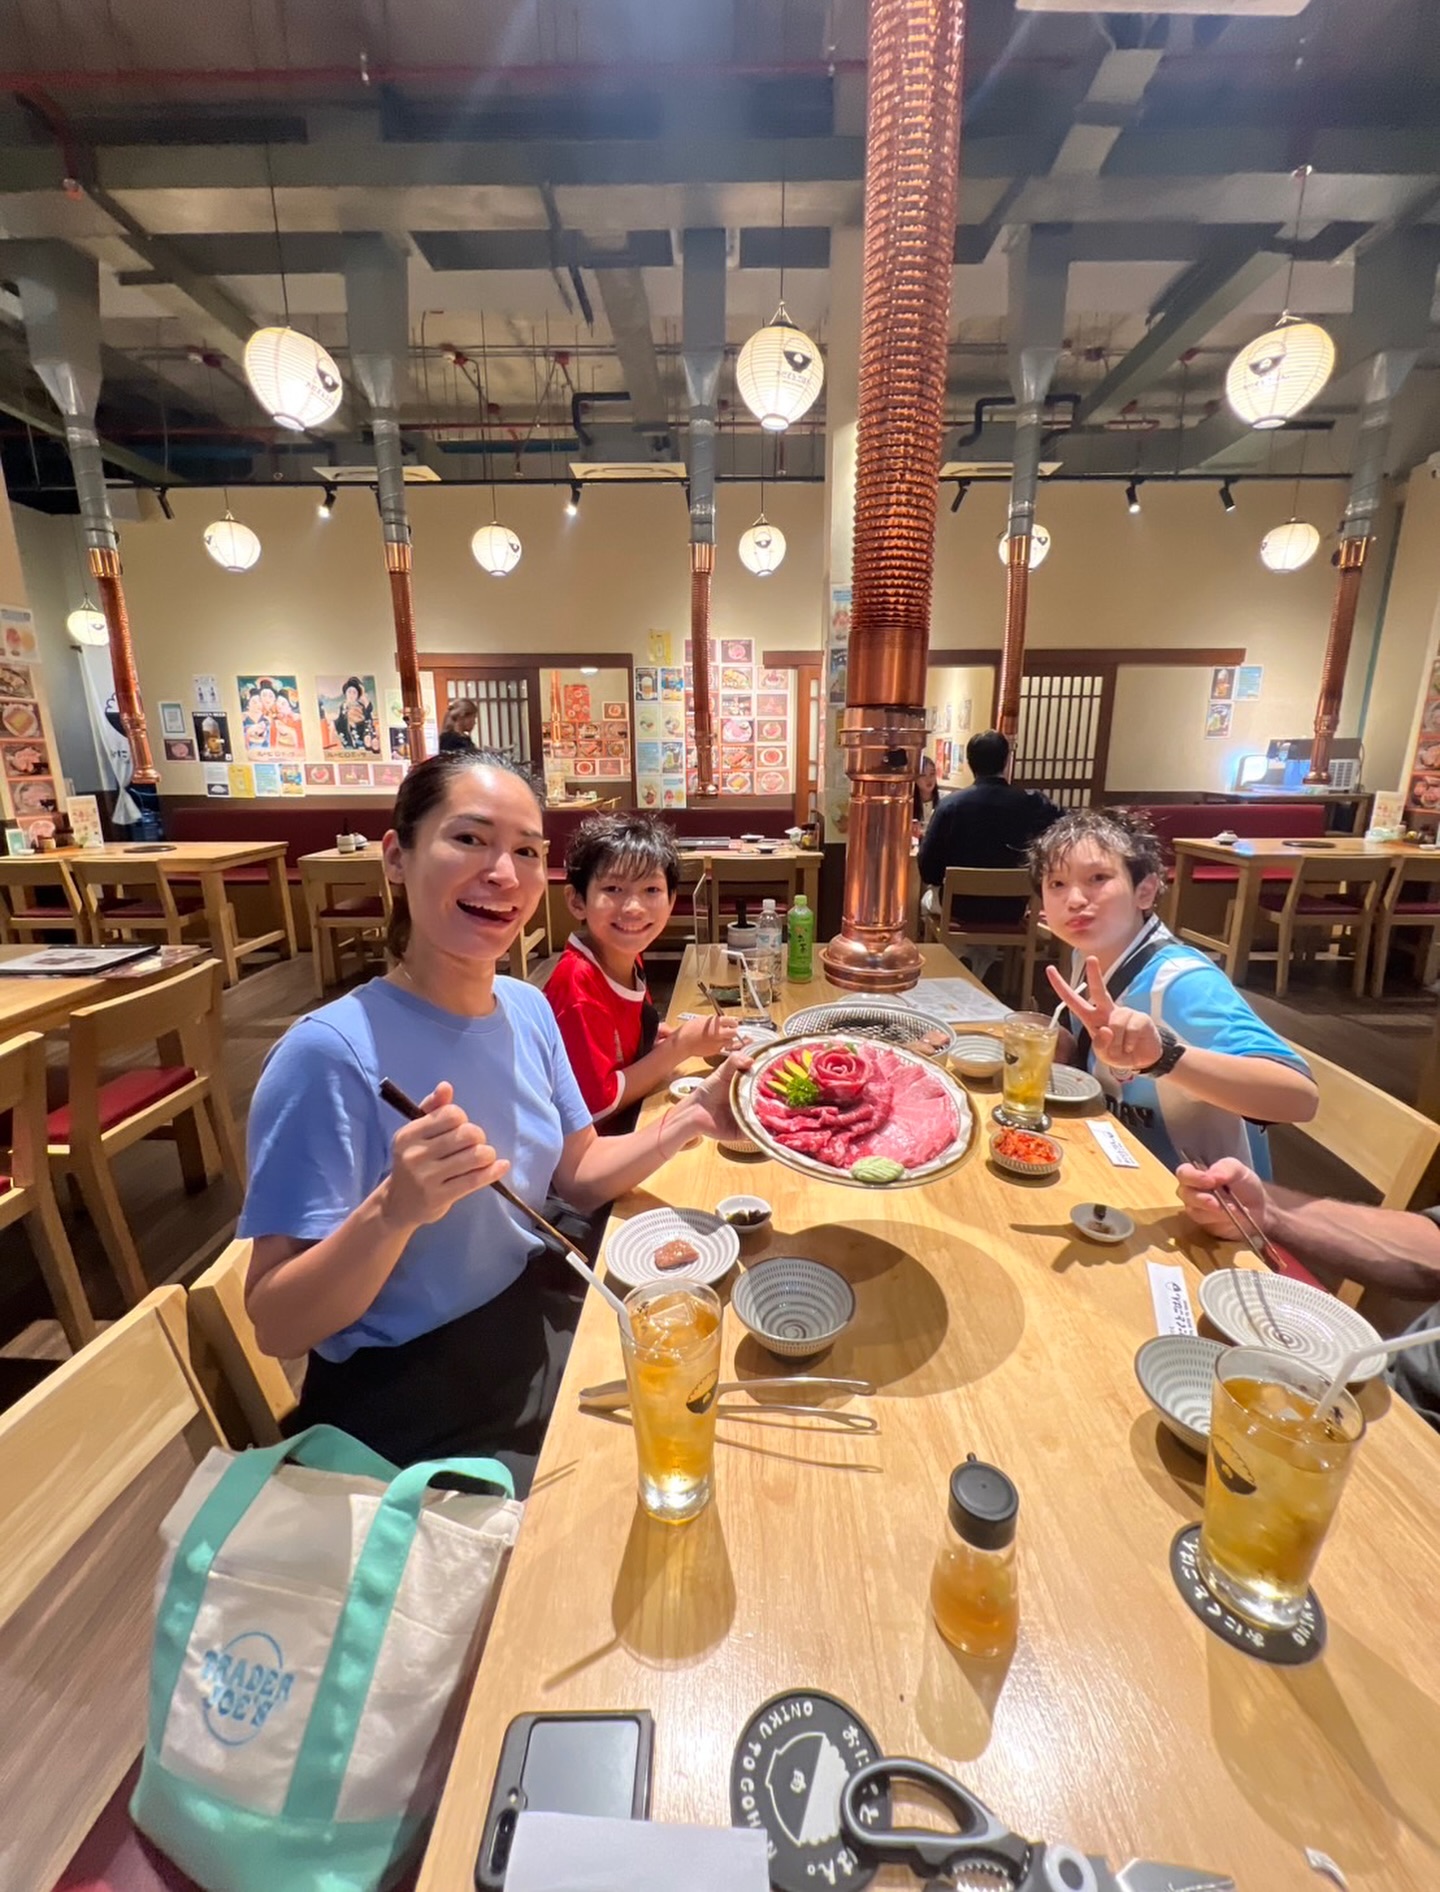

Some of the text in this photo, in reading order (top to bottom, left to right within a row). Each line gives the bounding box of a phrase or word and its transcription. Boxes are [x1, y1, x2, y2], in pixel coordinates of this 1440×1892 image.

[201, 1650, 295, 1702] TRADER
[203, 1684, 275, 1728] JOE'S
[759, 1700, 813, 1740] ONIKU
[743, 1741, 762, 1771] TO
